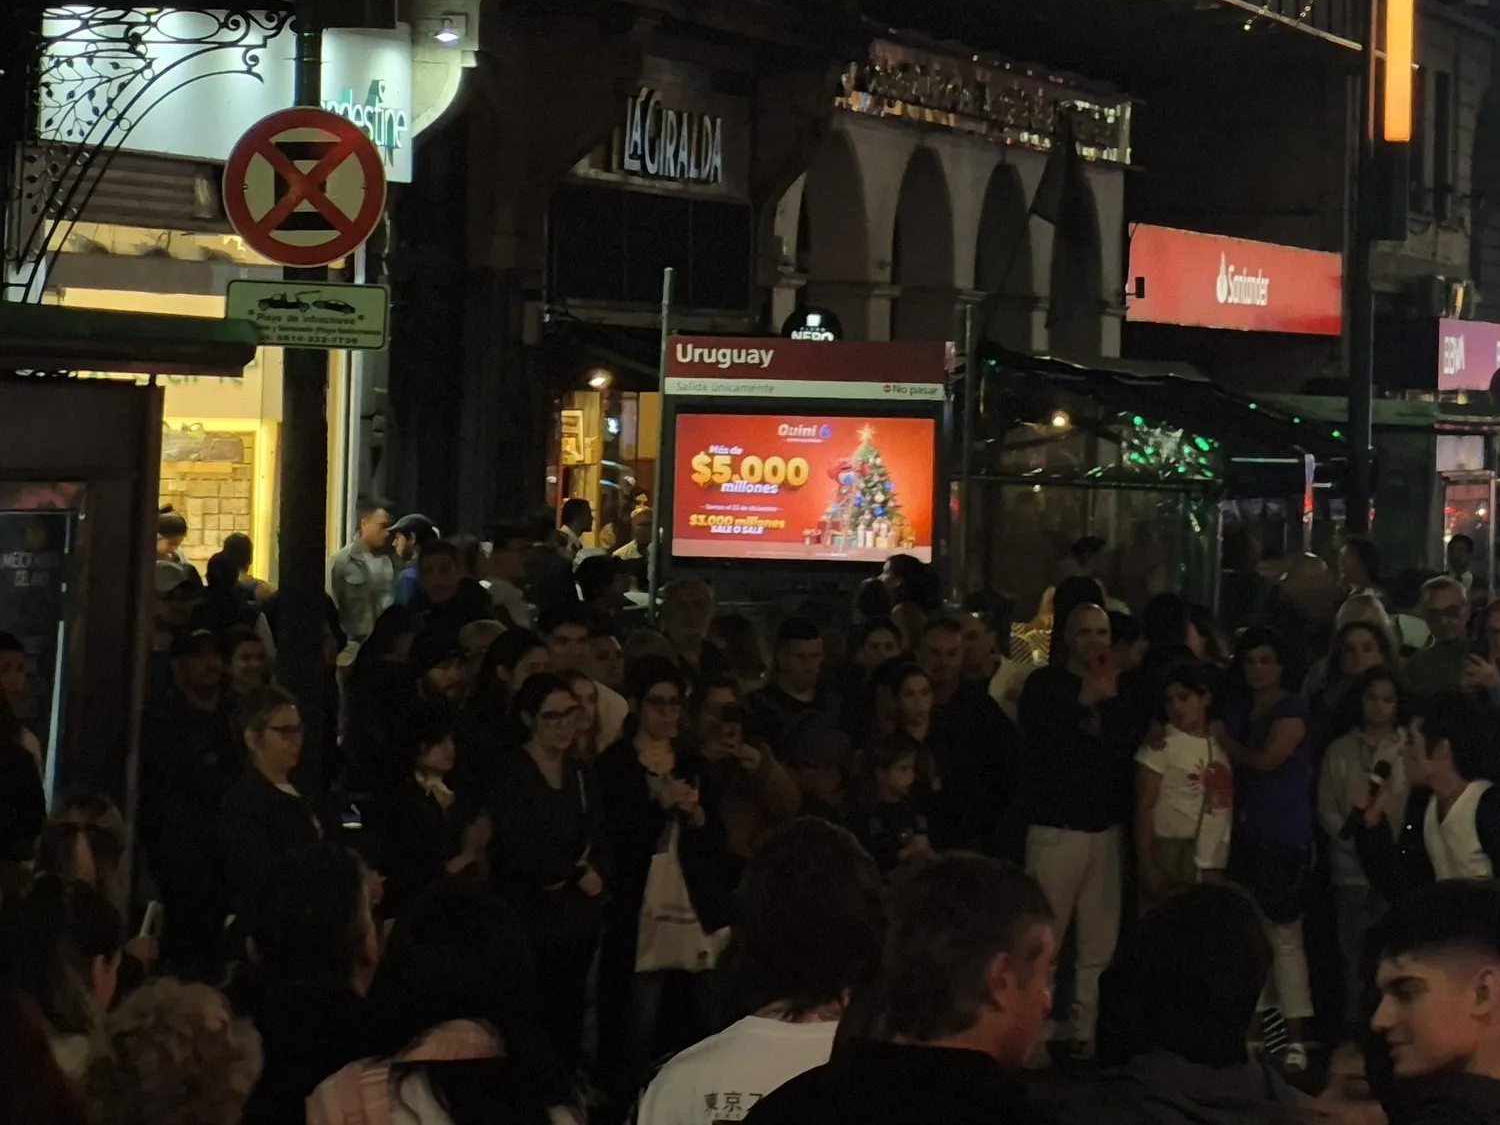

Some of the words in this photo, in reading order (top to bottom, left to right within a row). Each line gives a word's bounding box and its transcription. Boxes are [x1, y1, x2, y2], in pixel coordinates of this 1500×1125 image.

[645, 90, 722, 183] GIRALDA
[1228, 264, 1270, 306] Santander
[676, 343, 774, 368] Uruguay
[676, 381, 708, 392] Salida
[892, 384, 907, 394] No
[909, 385, 939, 397] pasar
[778, 423, 817, 437] Quini
[691, 451, 809, 487] $5.000
[720, 479, 779, 493] millones
[734, 515, 786, 528] millones
